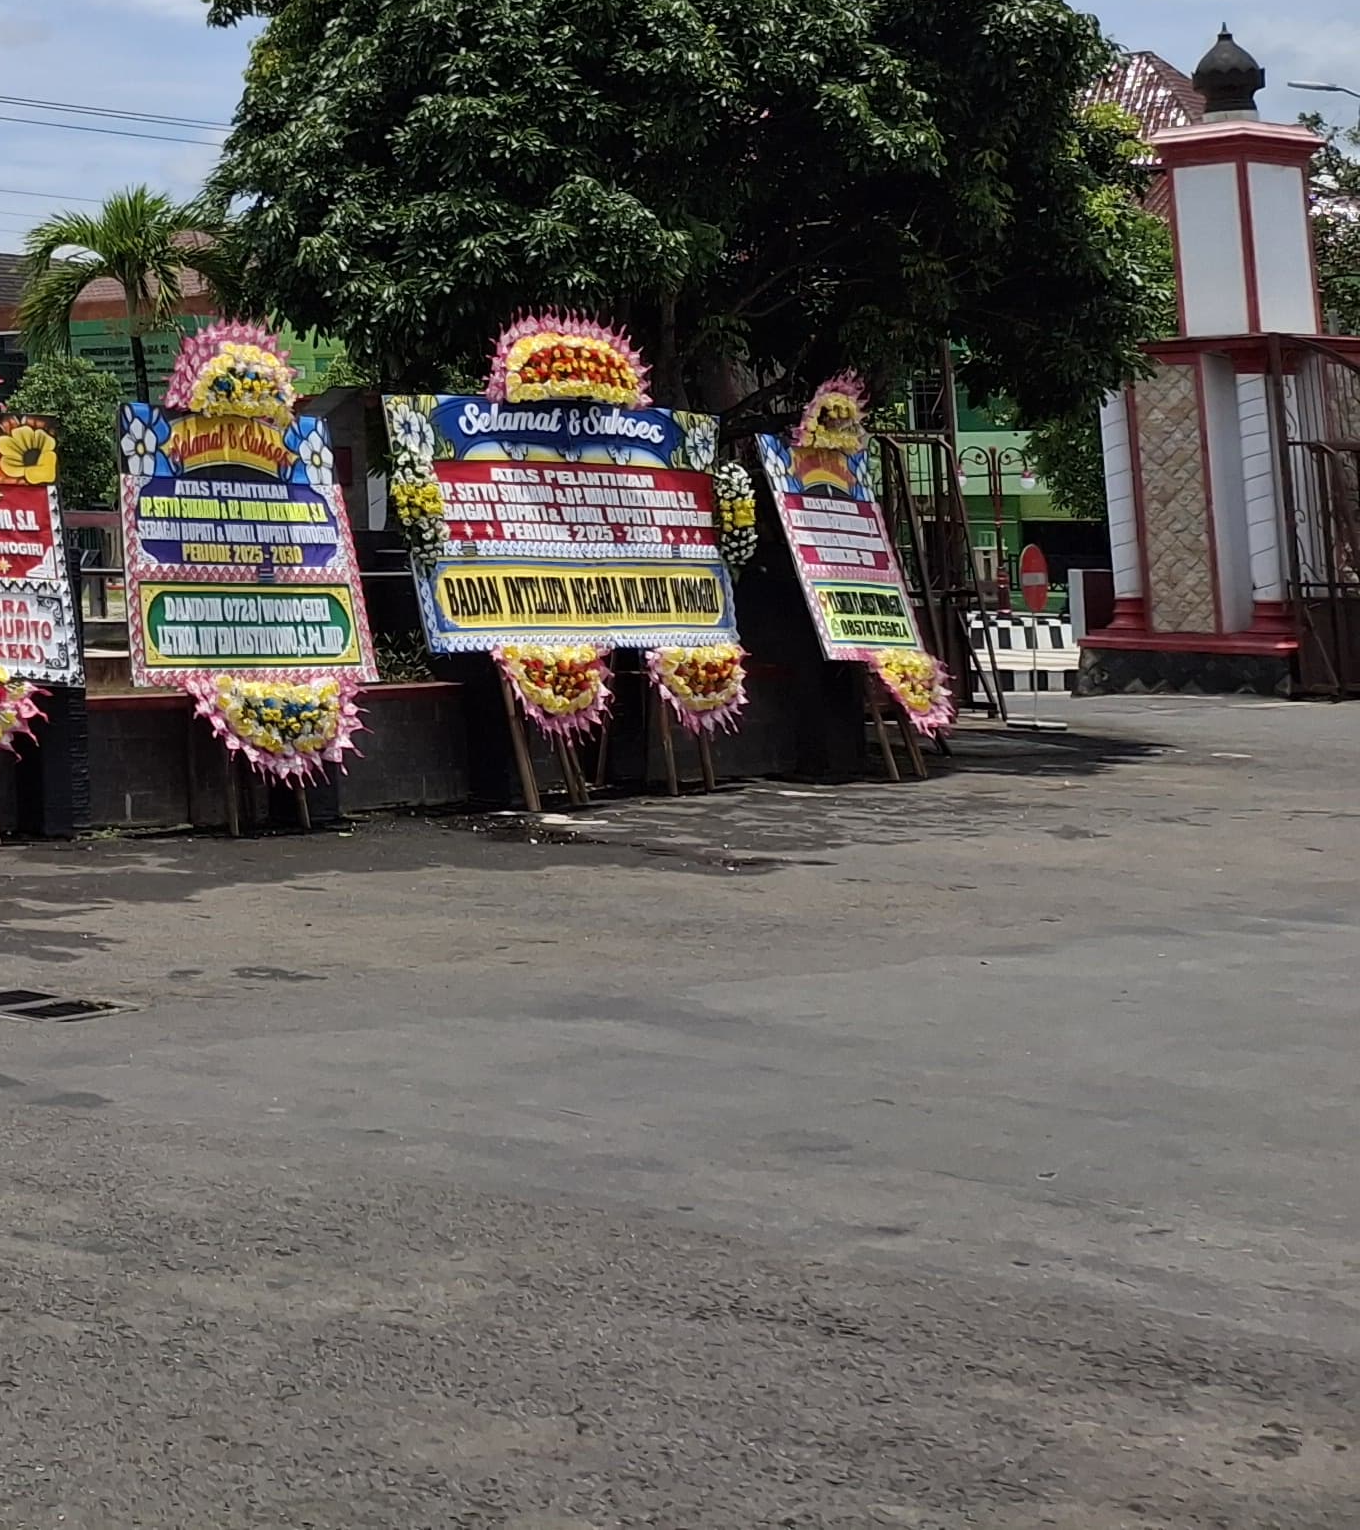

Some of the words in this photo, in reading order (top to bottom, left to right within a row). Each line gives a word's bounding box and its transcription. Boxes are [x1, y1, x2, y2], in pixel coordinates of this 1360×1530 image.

[459, 404, 561, 436] Selamat
[583, 407, 664, 443] Sukses
[170, 426, 225, 461] Selamat
[243, 423, 290, 467] Sukses
[490, 468, 539, 483] ATAS
[544, 470, 654, 487] PELANTIKAN
[175, 481, 210, 496] ATAS
[213, 483, 288, 499] PELANTIKAN
[496, 505, 547, 522] BUPATI
[503, 524, 572, 541] PERIODE
[575, 525, 613, 541] 2025
[625, 527, 661, 543] 2030
[183, 544, 232, 562] PERIODE
[444, 577, 503, 615] BADAN
[571, 577, 623, 614] NEGARA
[620, 577, 670, 613] WILAYAH
[671, 576, 719, 613] WONOGIRI
